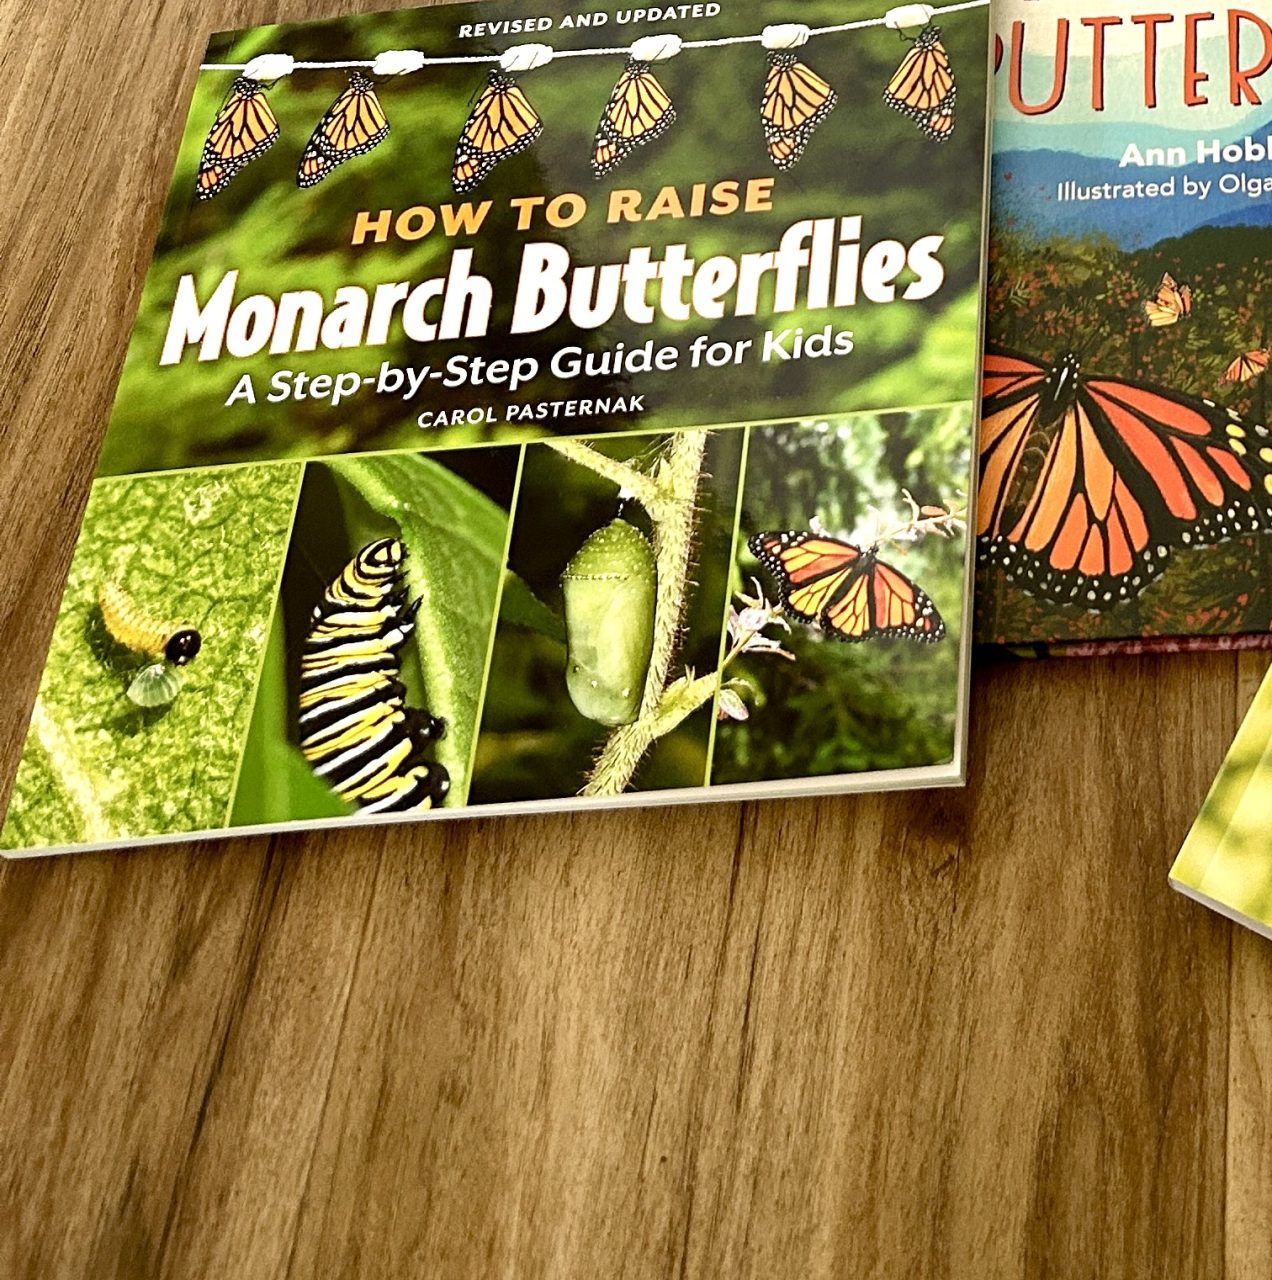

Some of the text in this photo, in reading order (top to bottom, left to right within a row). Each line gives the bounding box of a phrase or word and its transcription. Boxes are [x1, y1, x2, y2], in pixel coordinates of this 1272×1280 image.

[458, 2, 722, 40] REVISED AND UPDATED
[1119, 141, 1186, 168] Ann
[1057, 177, 1176, 202] Illustrated
[1183, 175, 1211, 199] by
[351, 177, 776, 246] HOW TO RAISE
[160, 214, 946, 367] Monarch Butterflies
[226, 326, 855, 407] A Step-by-Step Guide for Kids
[416, 393, 646, 430] CAROL PASTERNAK
